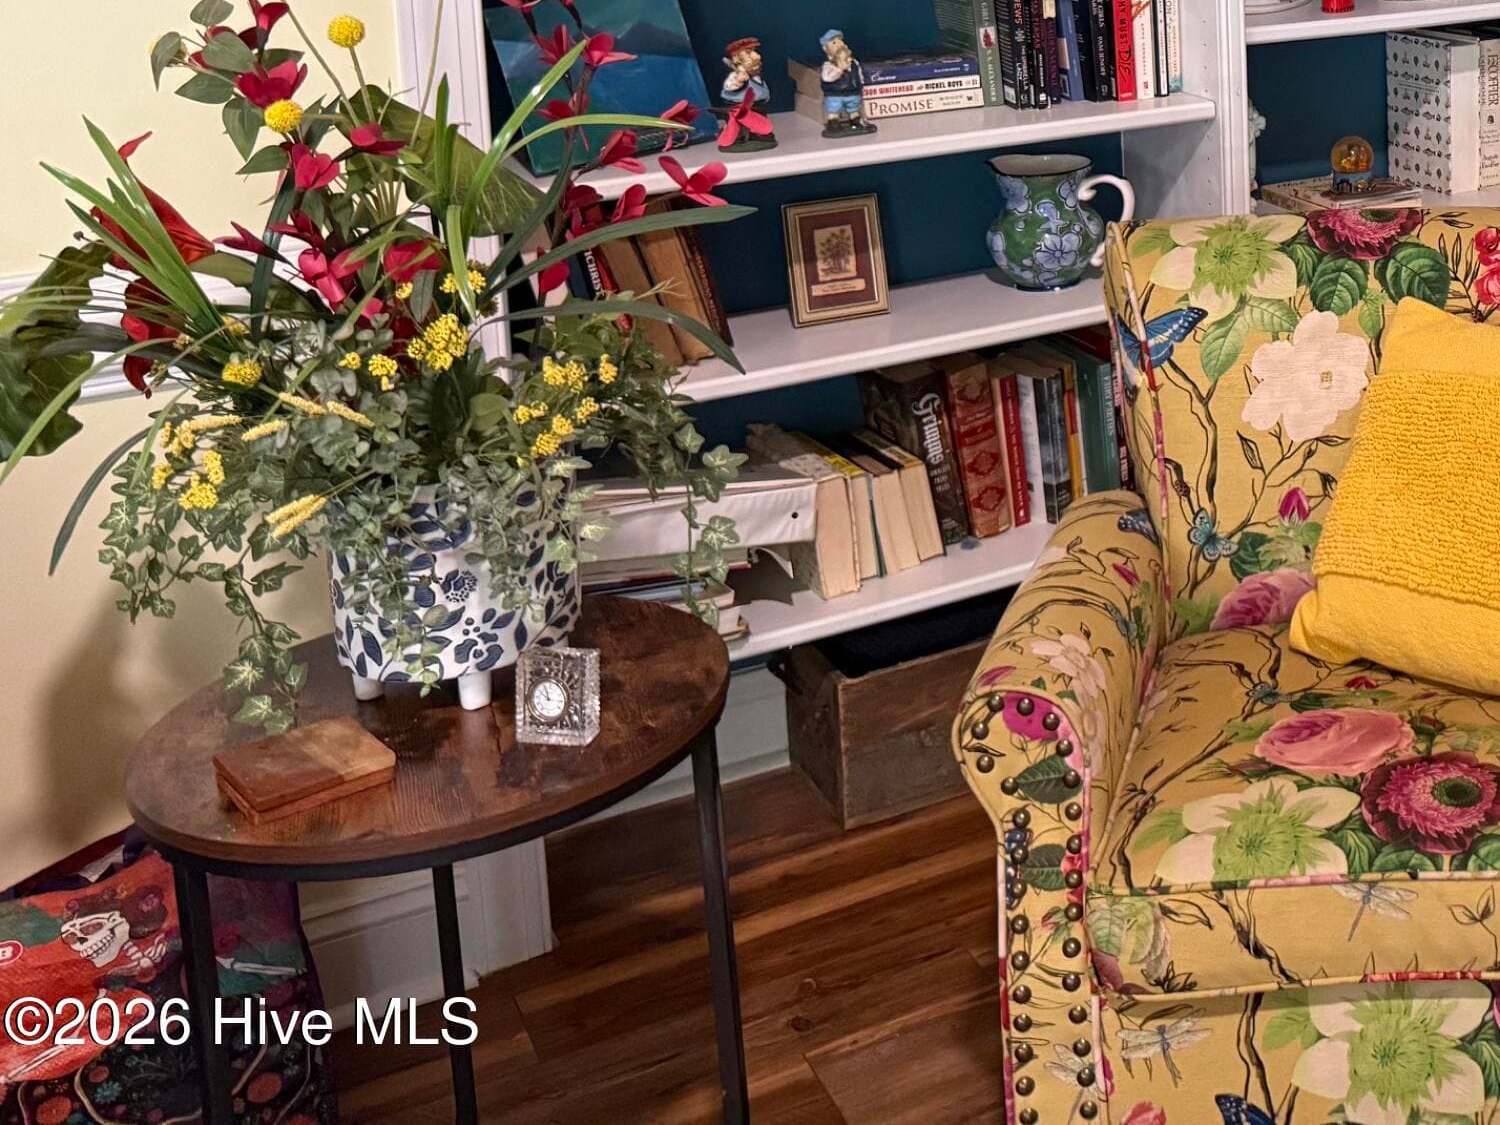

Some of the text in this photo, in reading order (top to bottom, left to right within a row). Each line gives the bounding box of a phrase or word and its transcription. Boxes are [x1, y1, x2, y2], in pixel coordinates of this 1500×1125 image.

[980, 2, 989, 26] GIRLS
[1119, 18, 1128, 45] MUST
[1021, 56, 1029, 91] UMBRELLA
[1118, 45, 1132, 83] DIE
[1487, 54, 1500, 106] ESCOFFIER
[879, 85, 914, 95] WHITEHEAD
[987, 63, 998, 102] ALEXANDER
